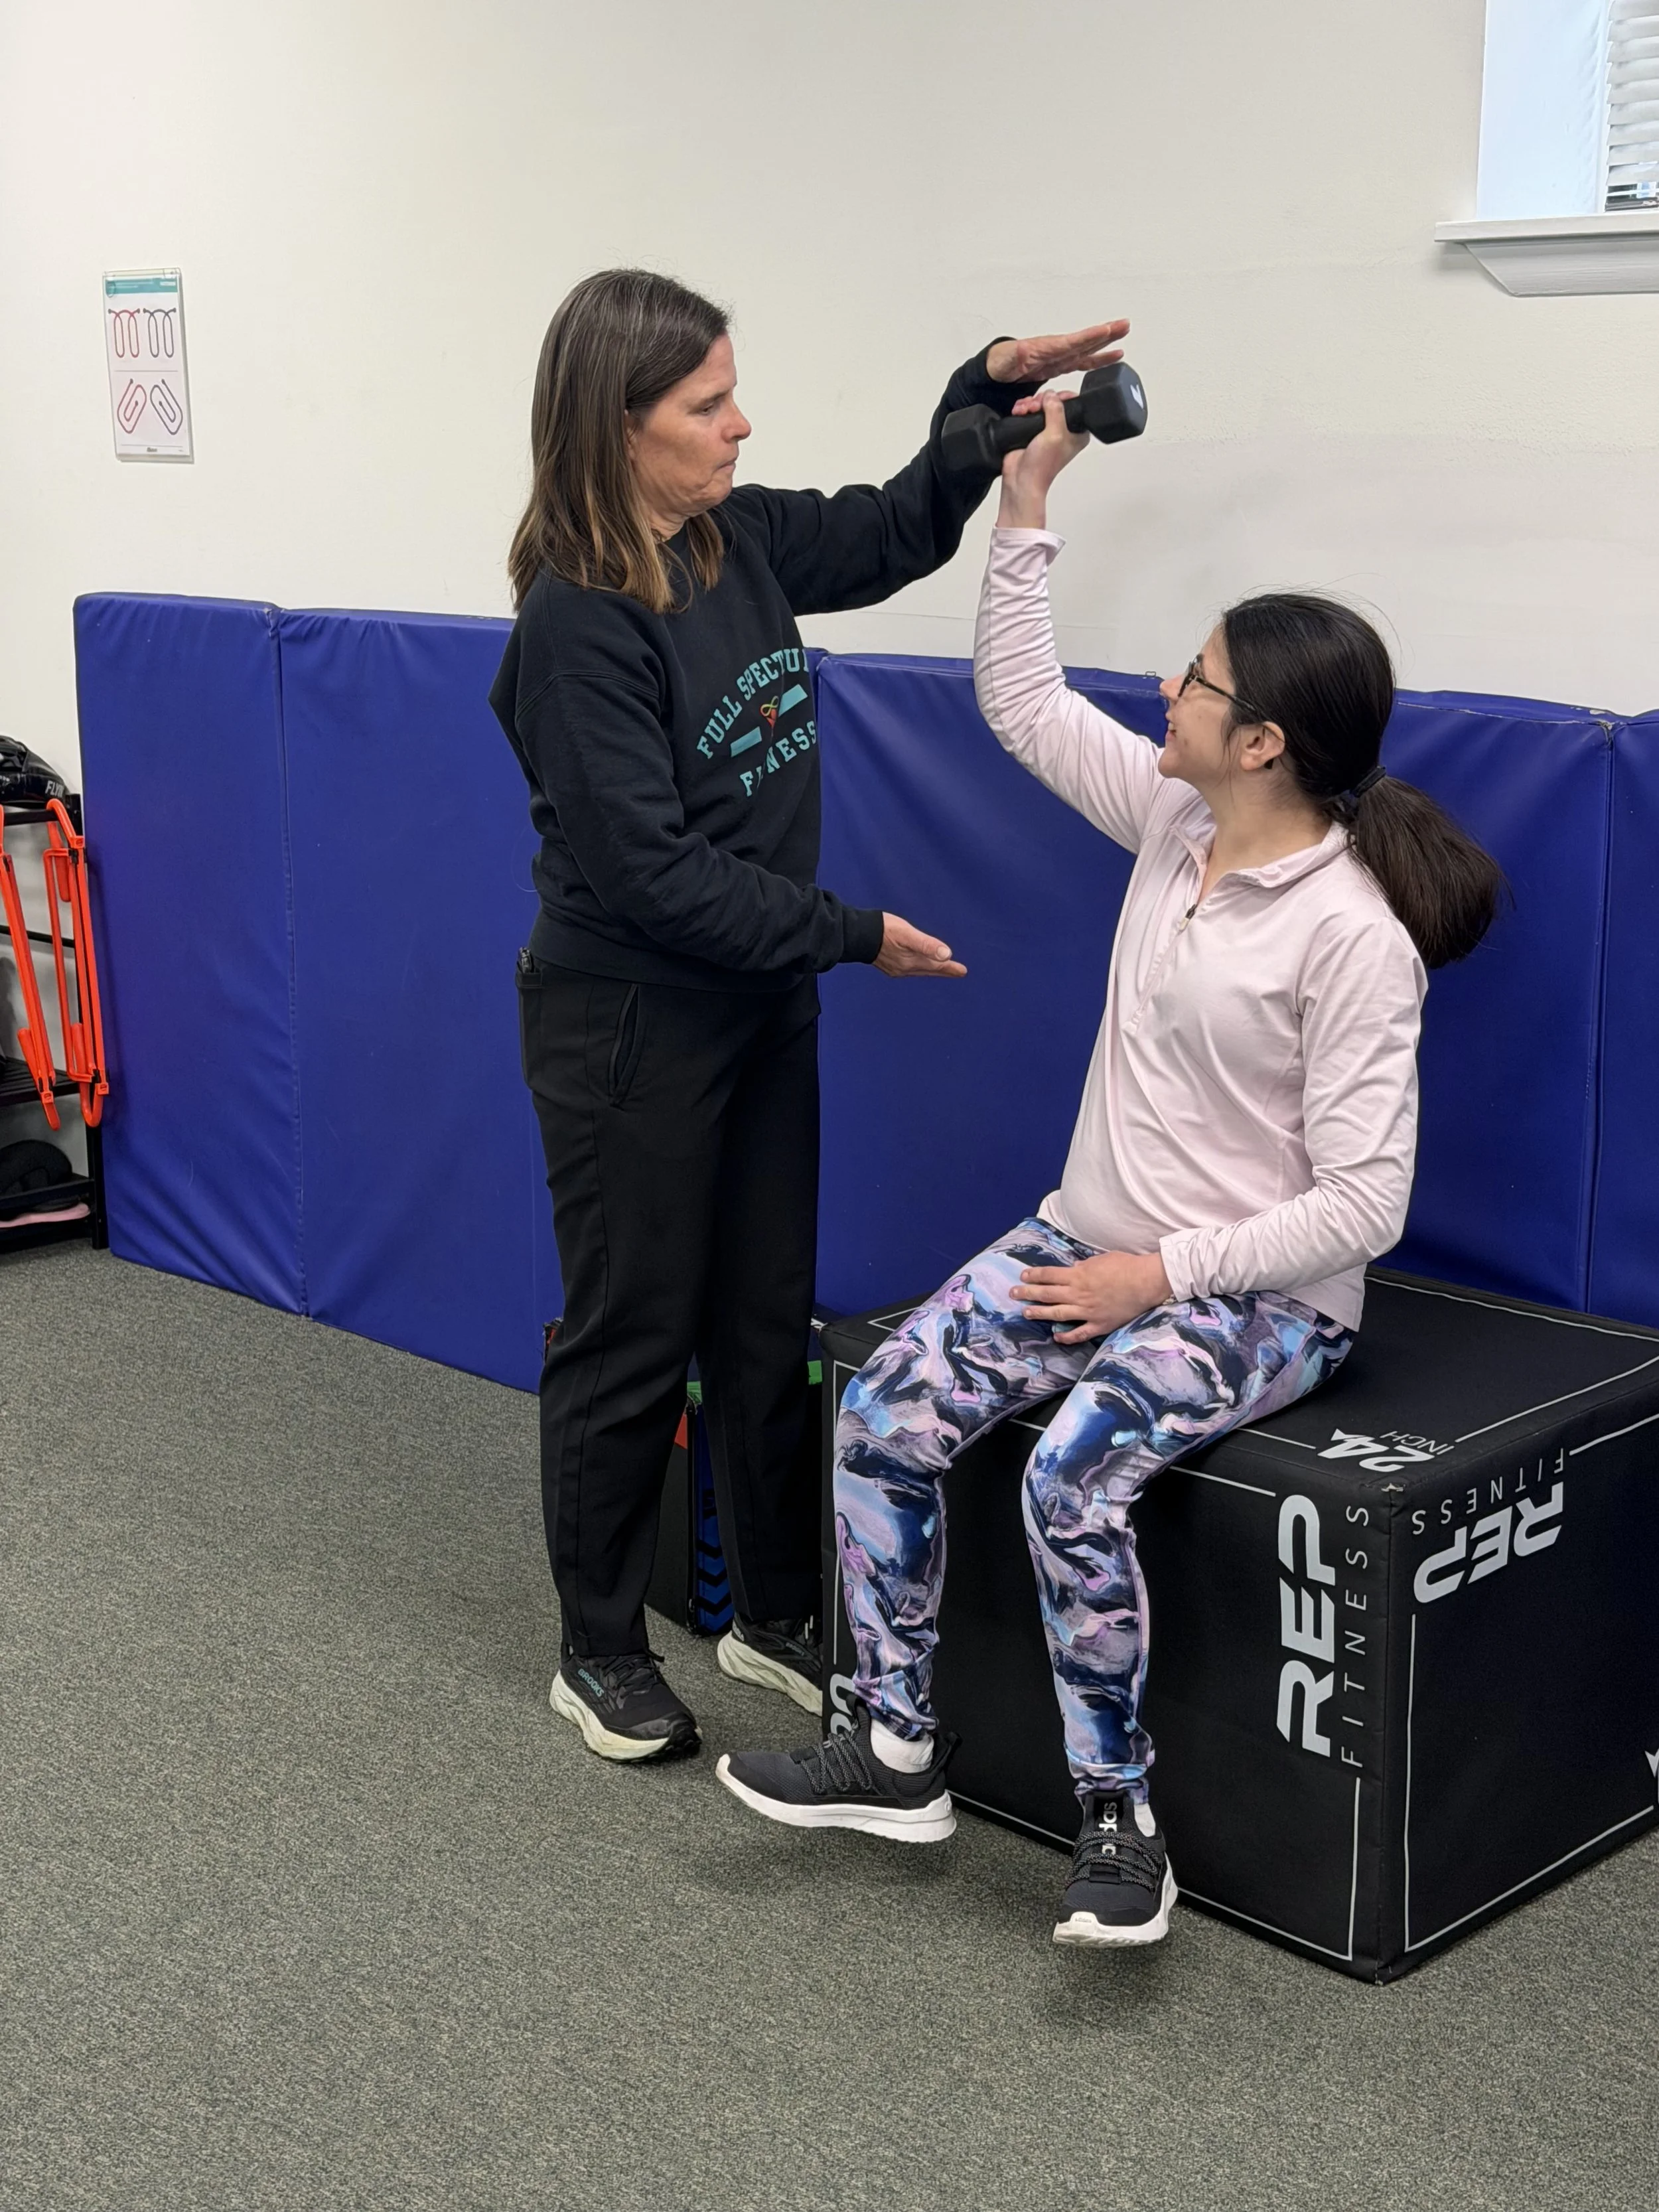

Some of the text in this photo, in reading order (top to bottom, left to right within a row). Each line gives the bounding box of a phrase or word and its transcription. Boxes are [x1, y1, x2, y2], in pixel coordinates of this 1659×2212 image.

[696, 695, 743, 759] FULL
[1317, 1428, 1435, 1473] 24
[1380, 1431, 1455, 1455] INCH
[1411, 1448, 1563, 1535] FITNESS
[1413, 1481, 1563, 1603] REP
[1277, 1494, 1336, 1757] REP
[1341, 1505, 1369, 1768] FITNESS
[577, 1668, 605, 1697] BROOKS
